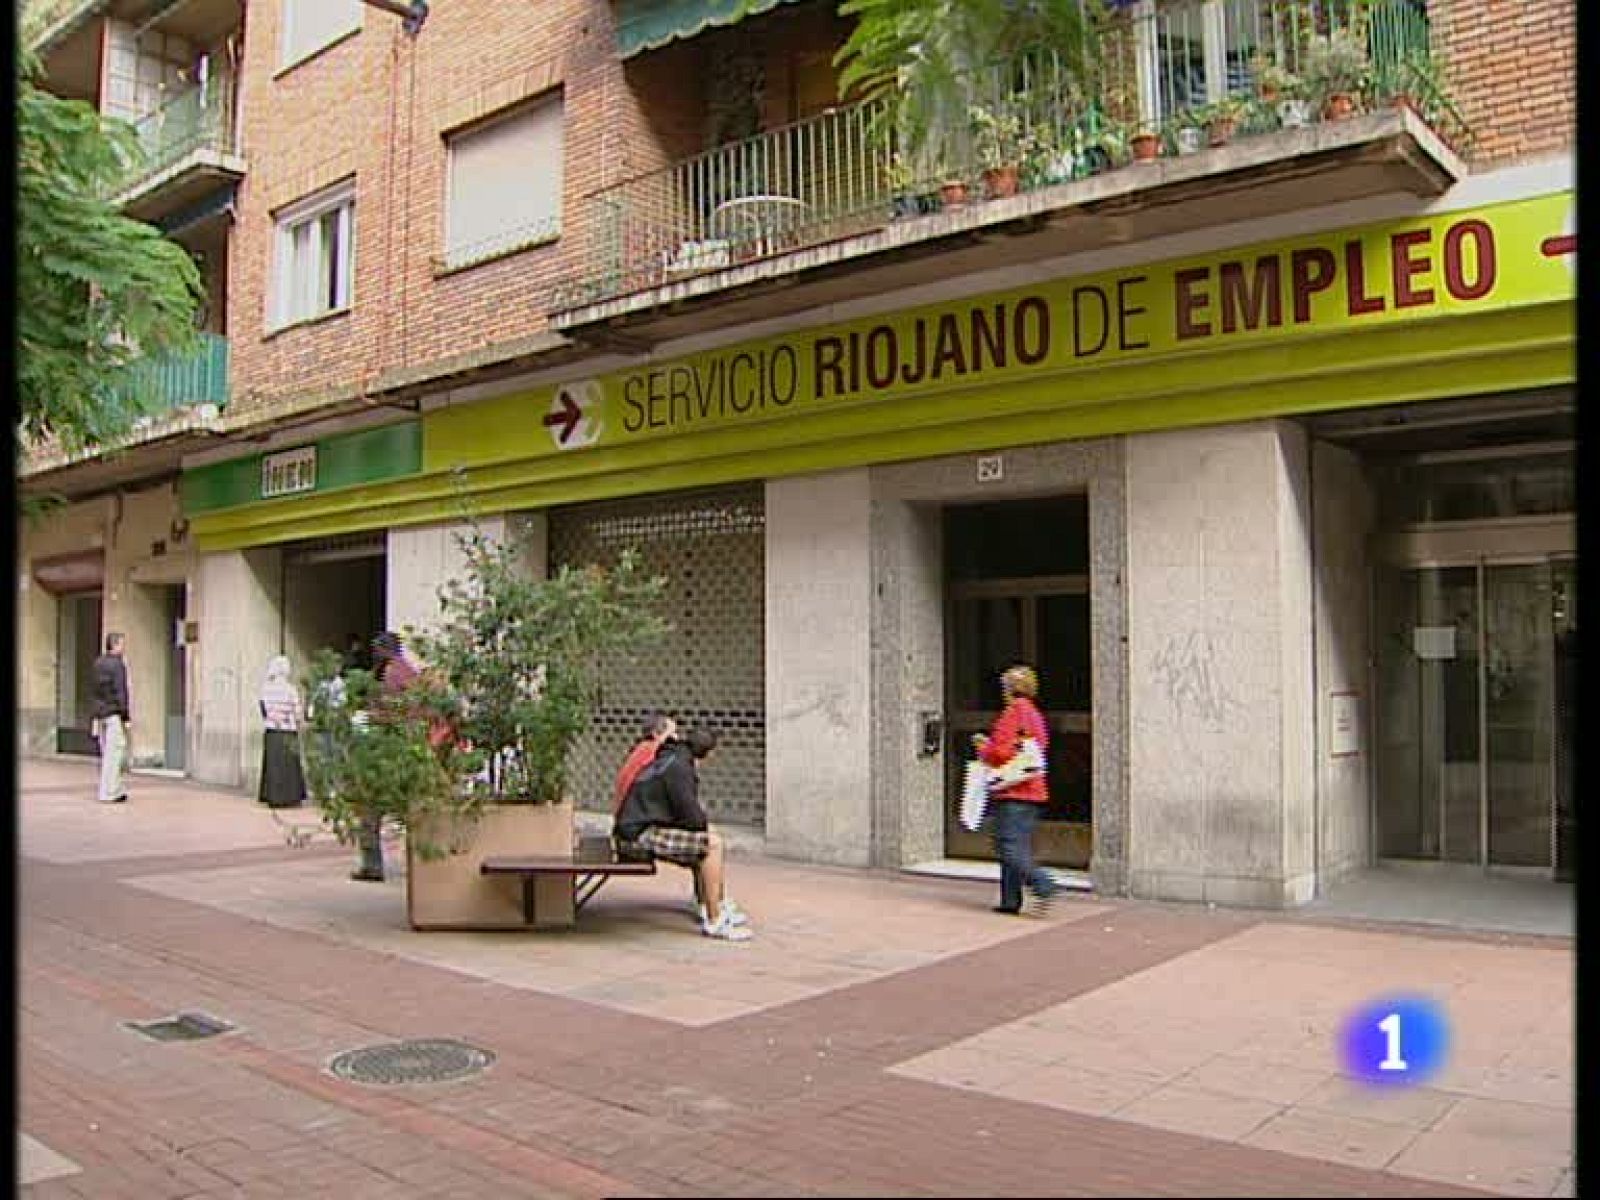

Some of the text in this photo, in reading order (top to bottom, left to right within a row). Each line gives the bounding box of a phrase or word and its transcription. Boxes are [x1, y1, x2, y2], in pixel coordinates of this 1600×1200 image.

[623, 218, 1496, 433] SERVICIO RIOJANO DE EMPLEO
